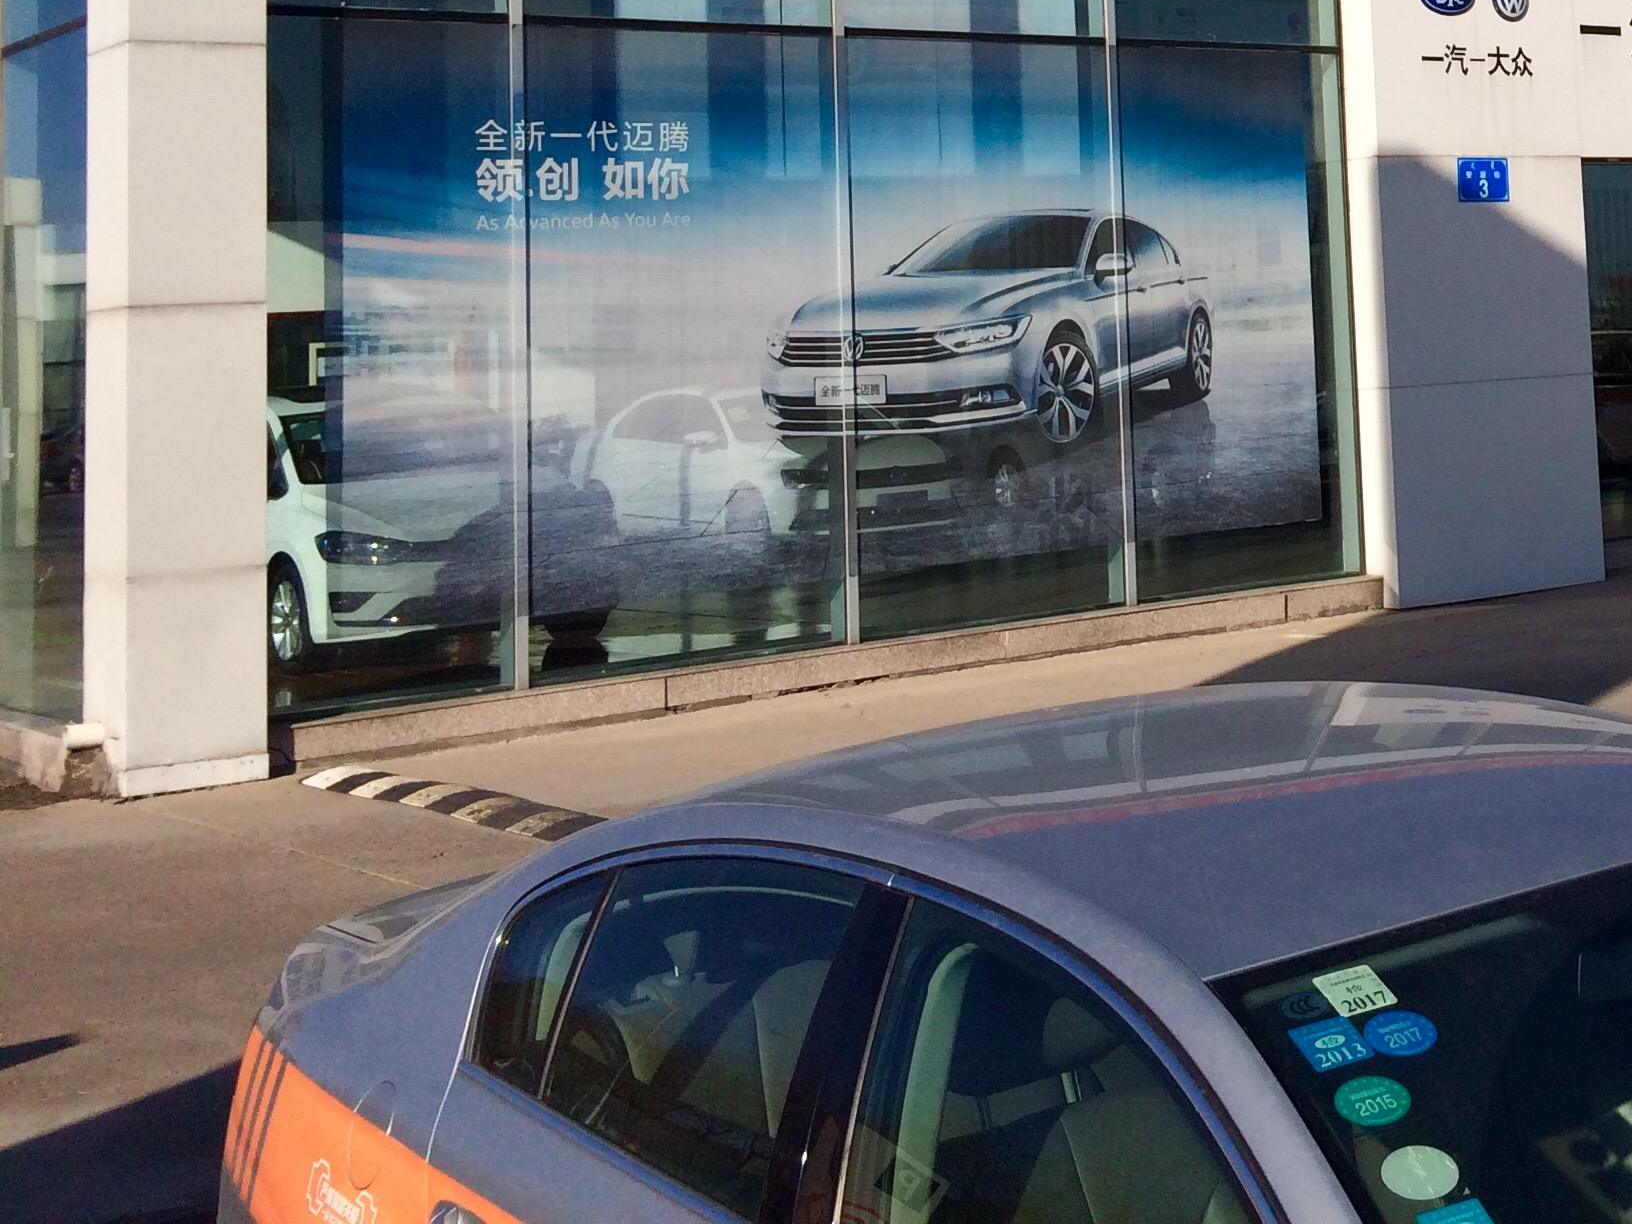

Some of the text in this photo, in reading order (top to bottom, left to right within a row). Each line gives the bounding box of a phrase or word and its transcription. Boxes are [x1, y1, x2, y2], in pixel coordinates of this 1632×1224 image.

[475, 119, 689, 152] 全新一代迈腾
[1479, 179, 1489, 198] 3
[476, 215, 498, 231] As
[599, 212, 621, 228] As
[625, 212, 657, 228] You
[661, 211, 691, 228] Are
[1341, 990, 1387, 1013] 2017
[1384, 1026, 1423, 1049] 2017
[1315, 1042, 1367, 1068] 2013
[1355, 1093, 1397, 1118] 2015
